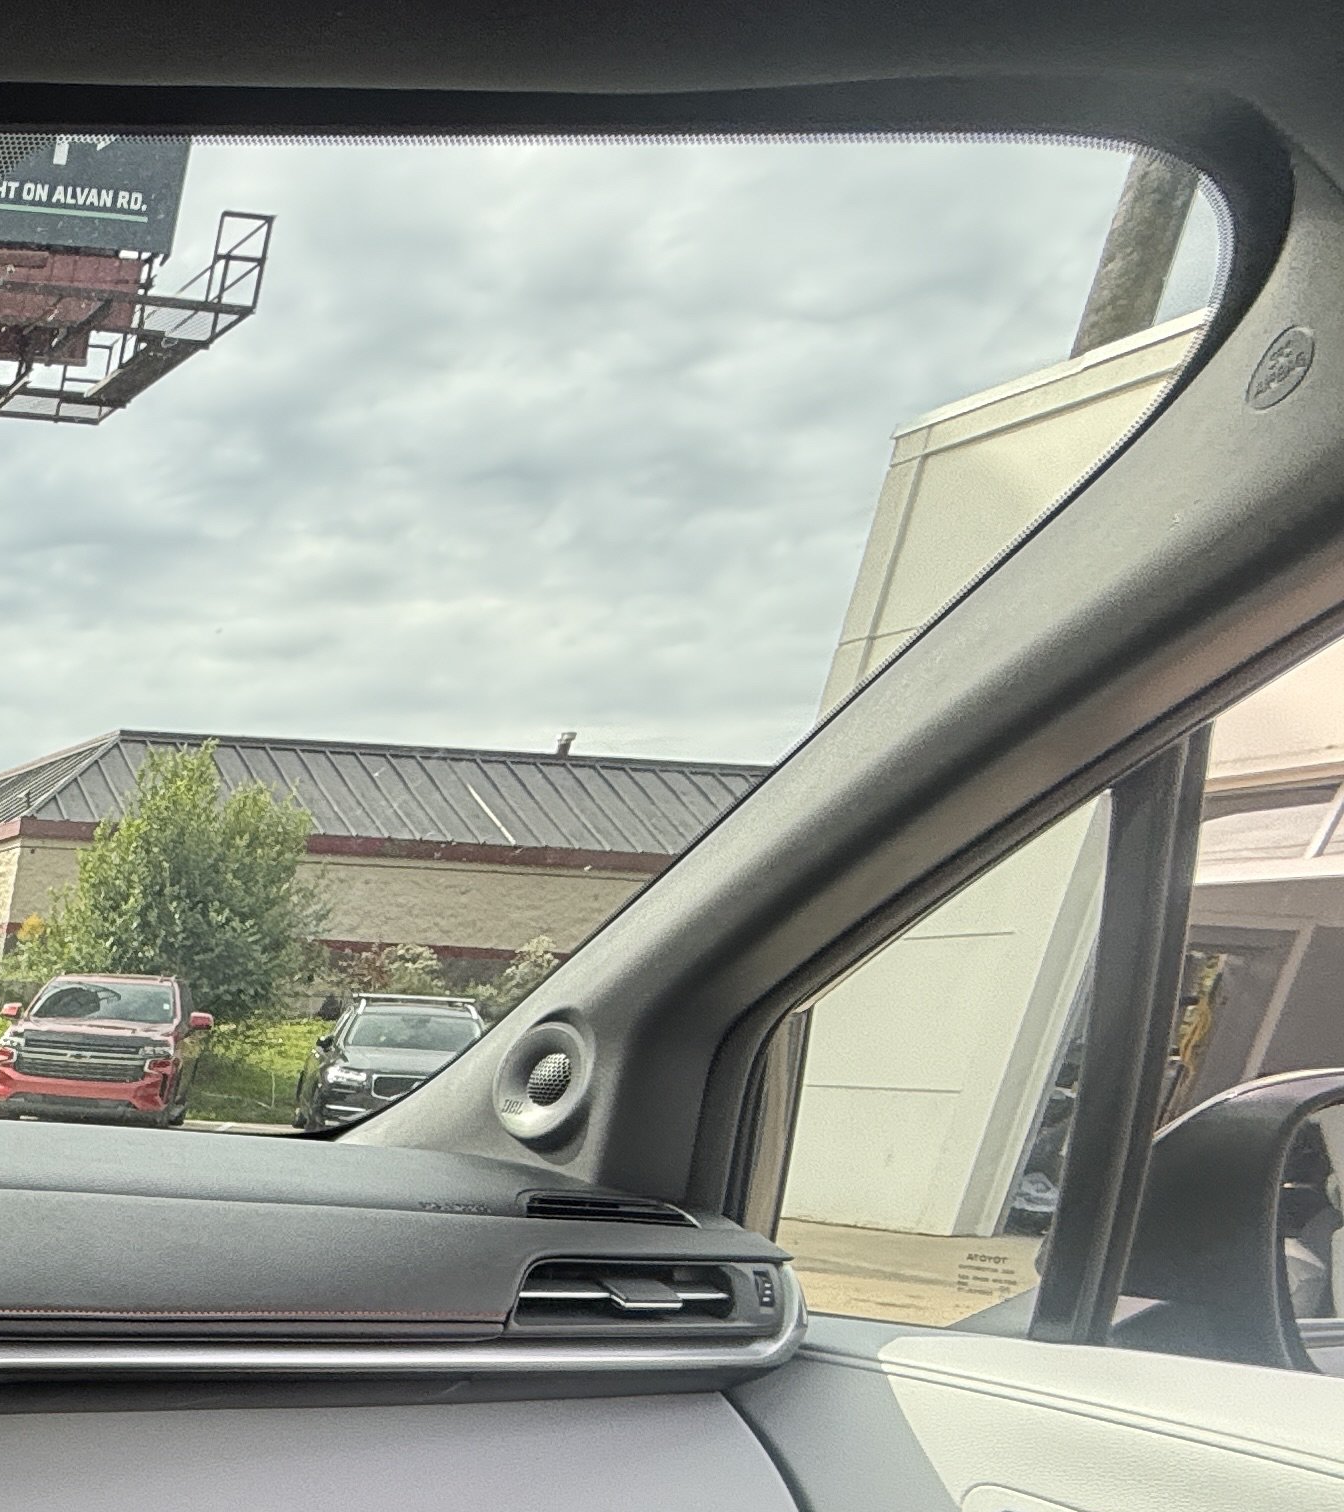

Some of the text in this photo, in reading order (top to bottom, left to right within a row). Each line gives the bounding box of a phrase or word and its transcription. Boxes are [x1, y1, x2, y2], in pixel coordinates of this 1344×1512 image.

[22, 182, 49, 202] ON
[52, 186, 114, 208] ALVAN
[116, 190, 147, 212] RD.
